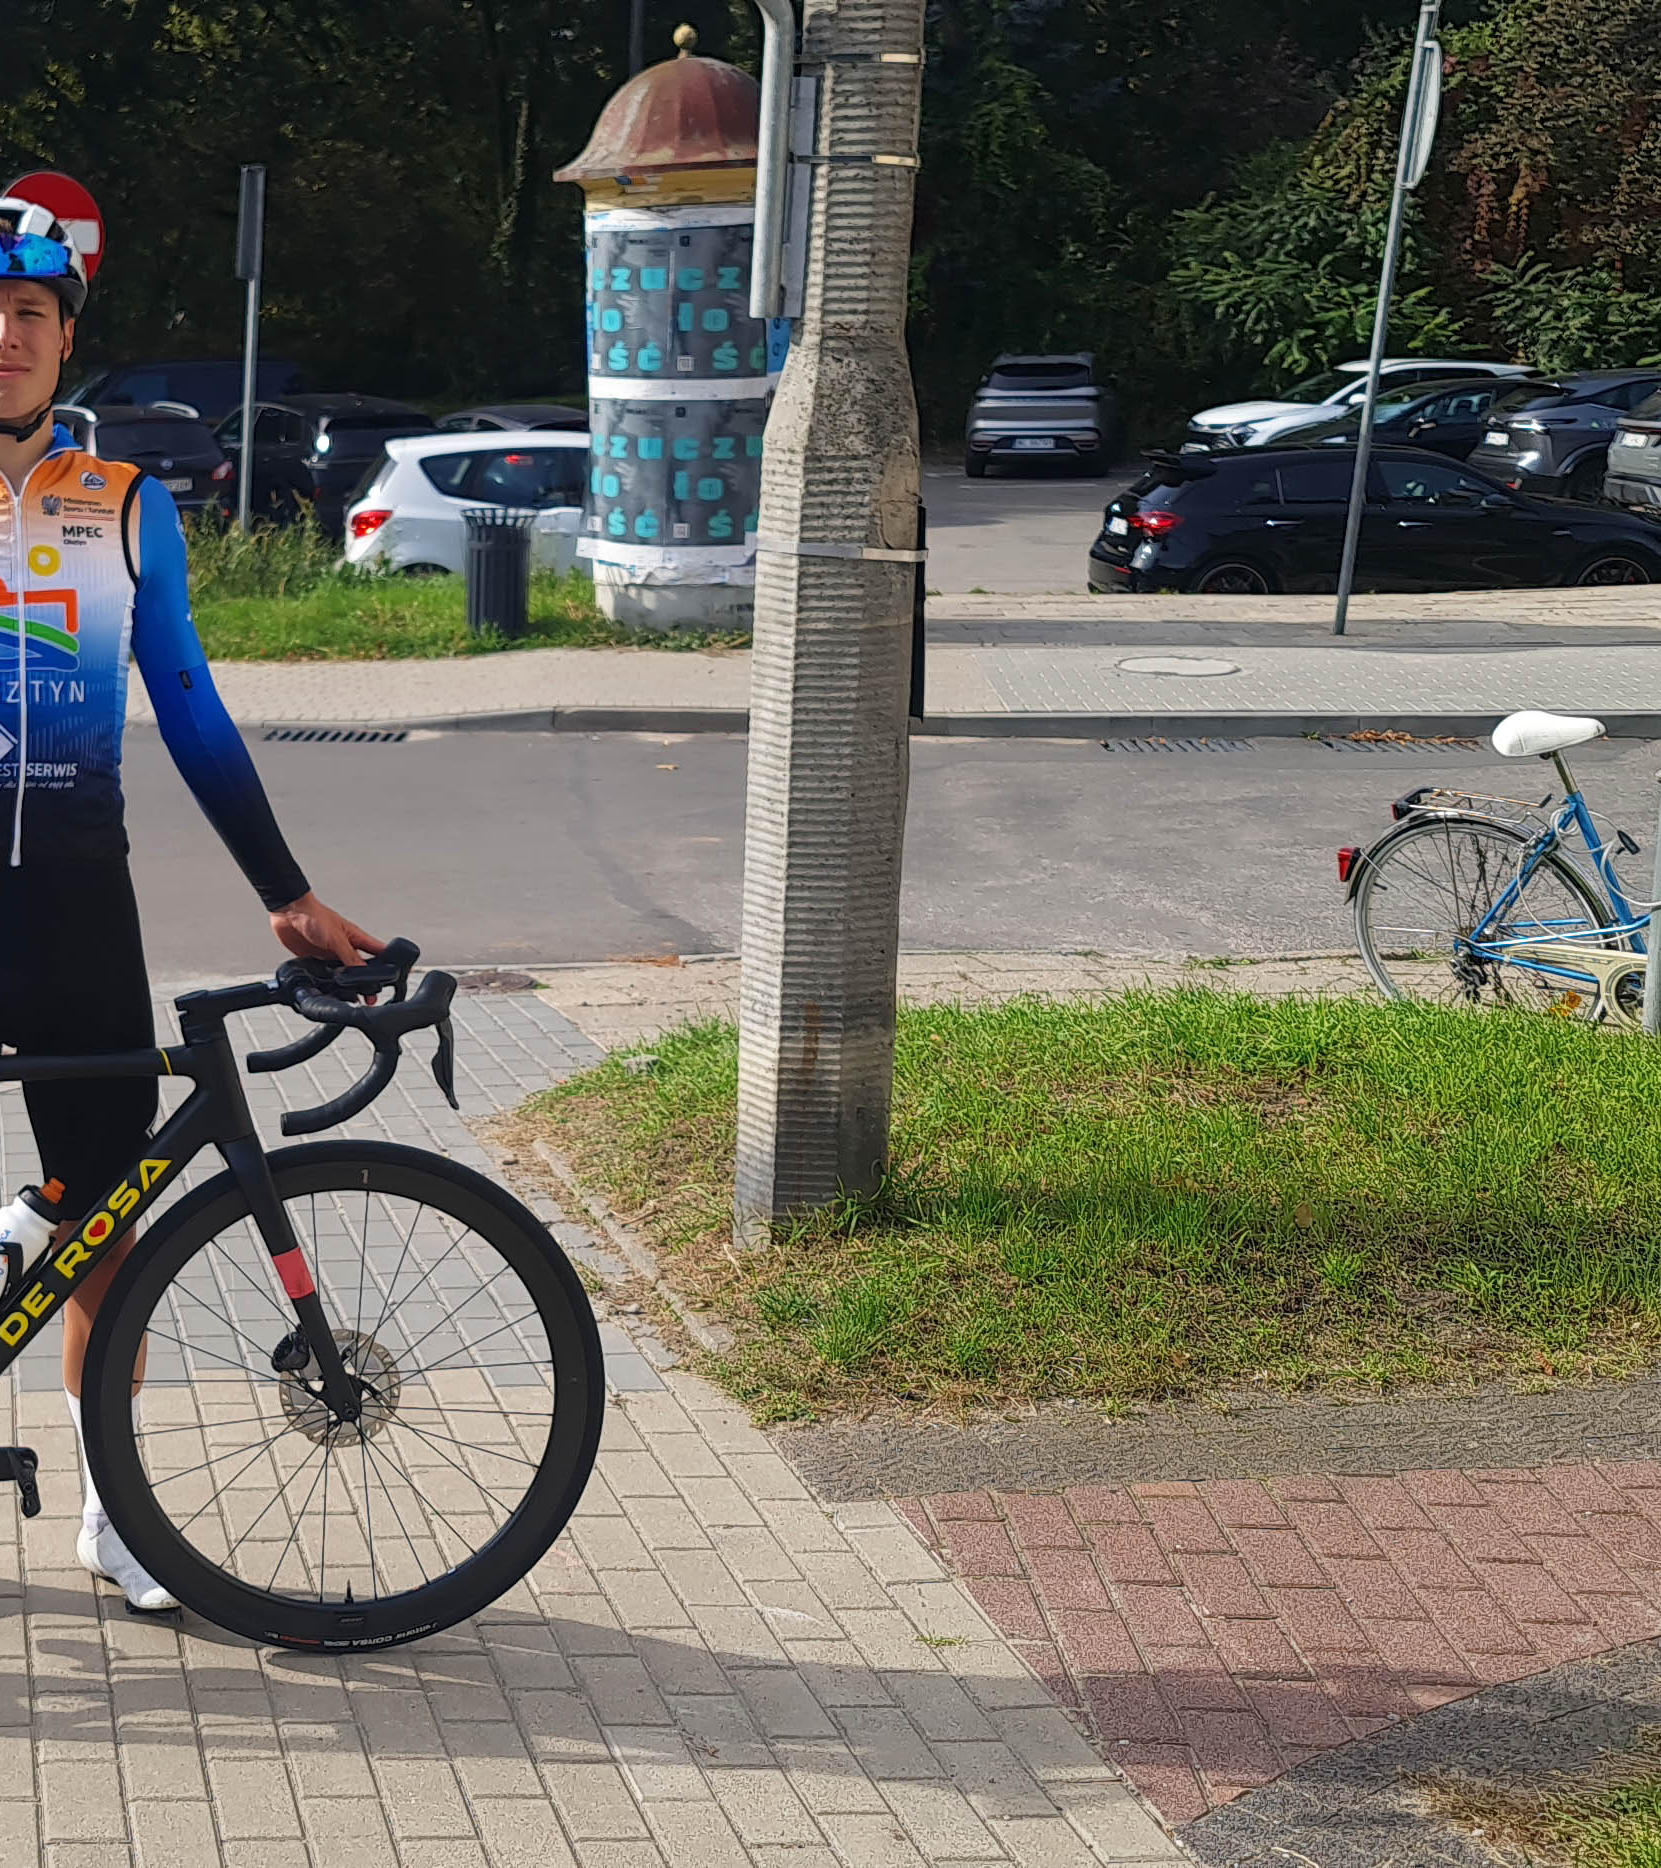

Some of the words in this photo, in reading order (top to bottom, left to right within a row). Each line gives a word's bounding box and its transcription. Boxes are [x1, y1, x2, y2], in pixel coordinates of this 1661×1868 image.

[62, 526, 103, 539] MPEC
[25, 763, 78, 777] SERWIS
[53, 1158, 173, 1280] ROSA
